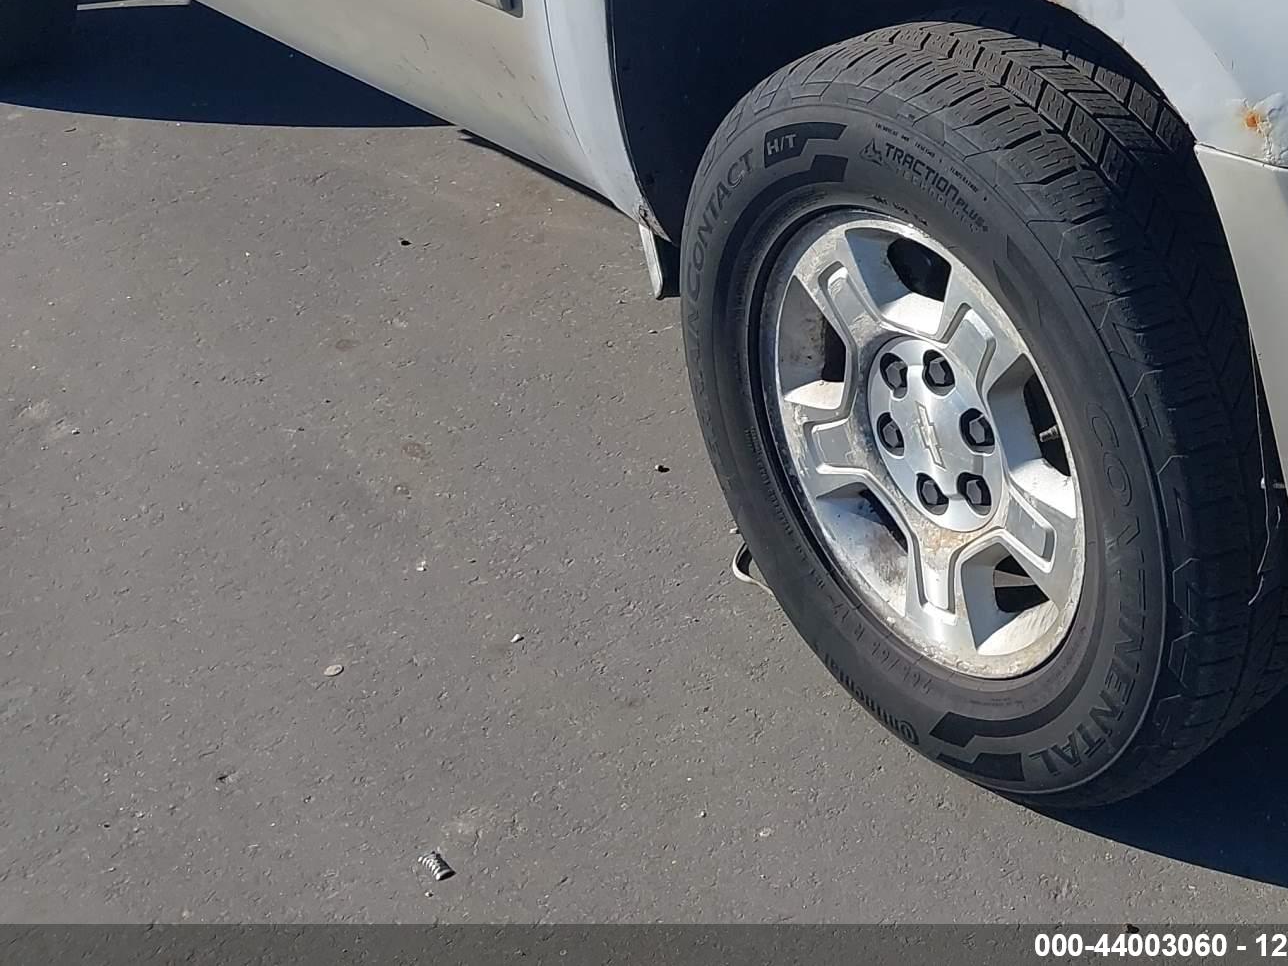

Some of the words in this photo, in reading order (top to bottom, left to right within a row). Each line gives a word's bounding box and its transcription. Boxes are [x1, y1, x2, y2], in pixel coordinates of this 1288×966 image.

[766, 134, 798, 156] H/T
[885, 142, 960, 201] TRACTION
[1028, 401, 1147, 777] CONTINENTAL
